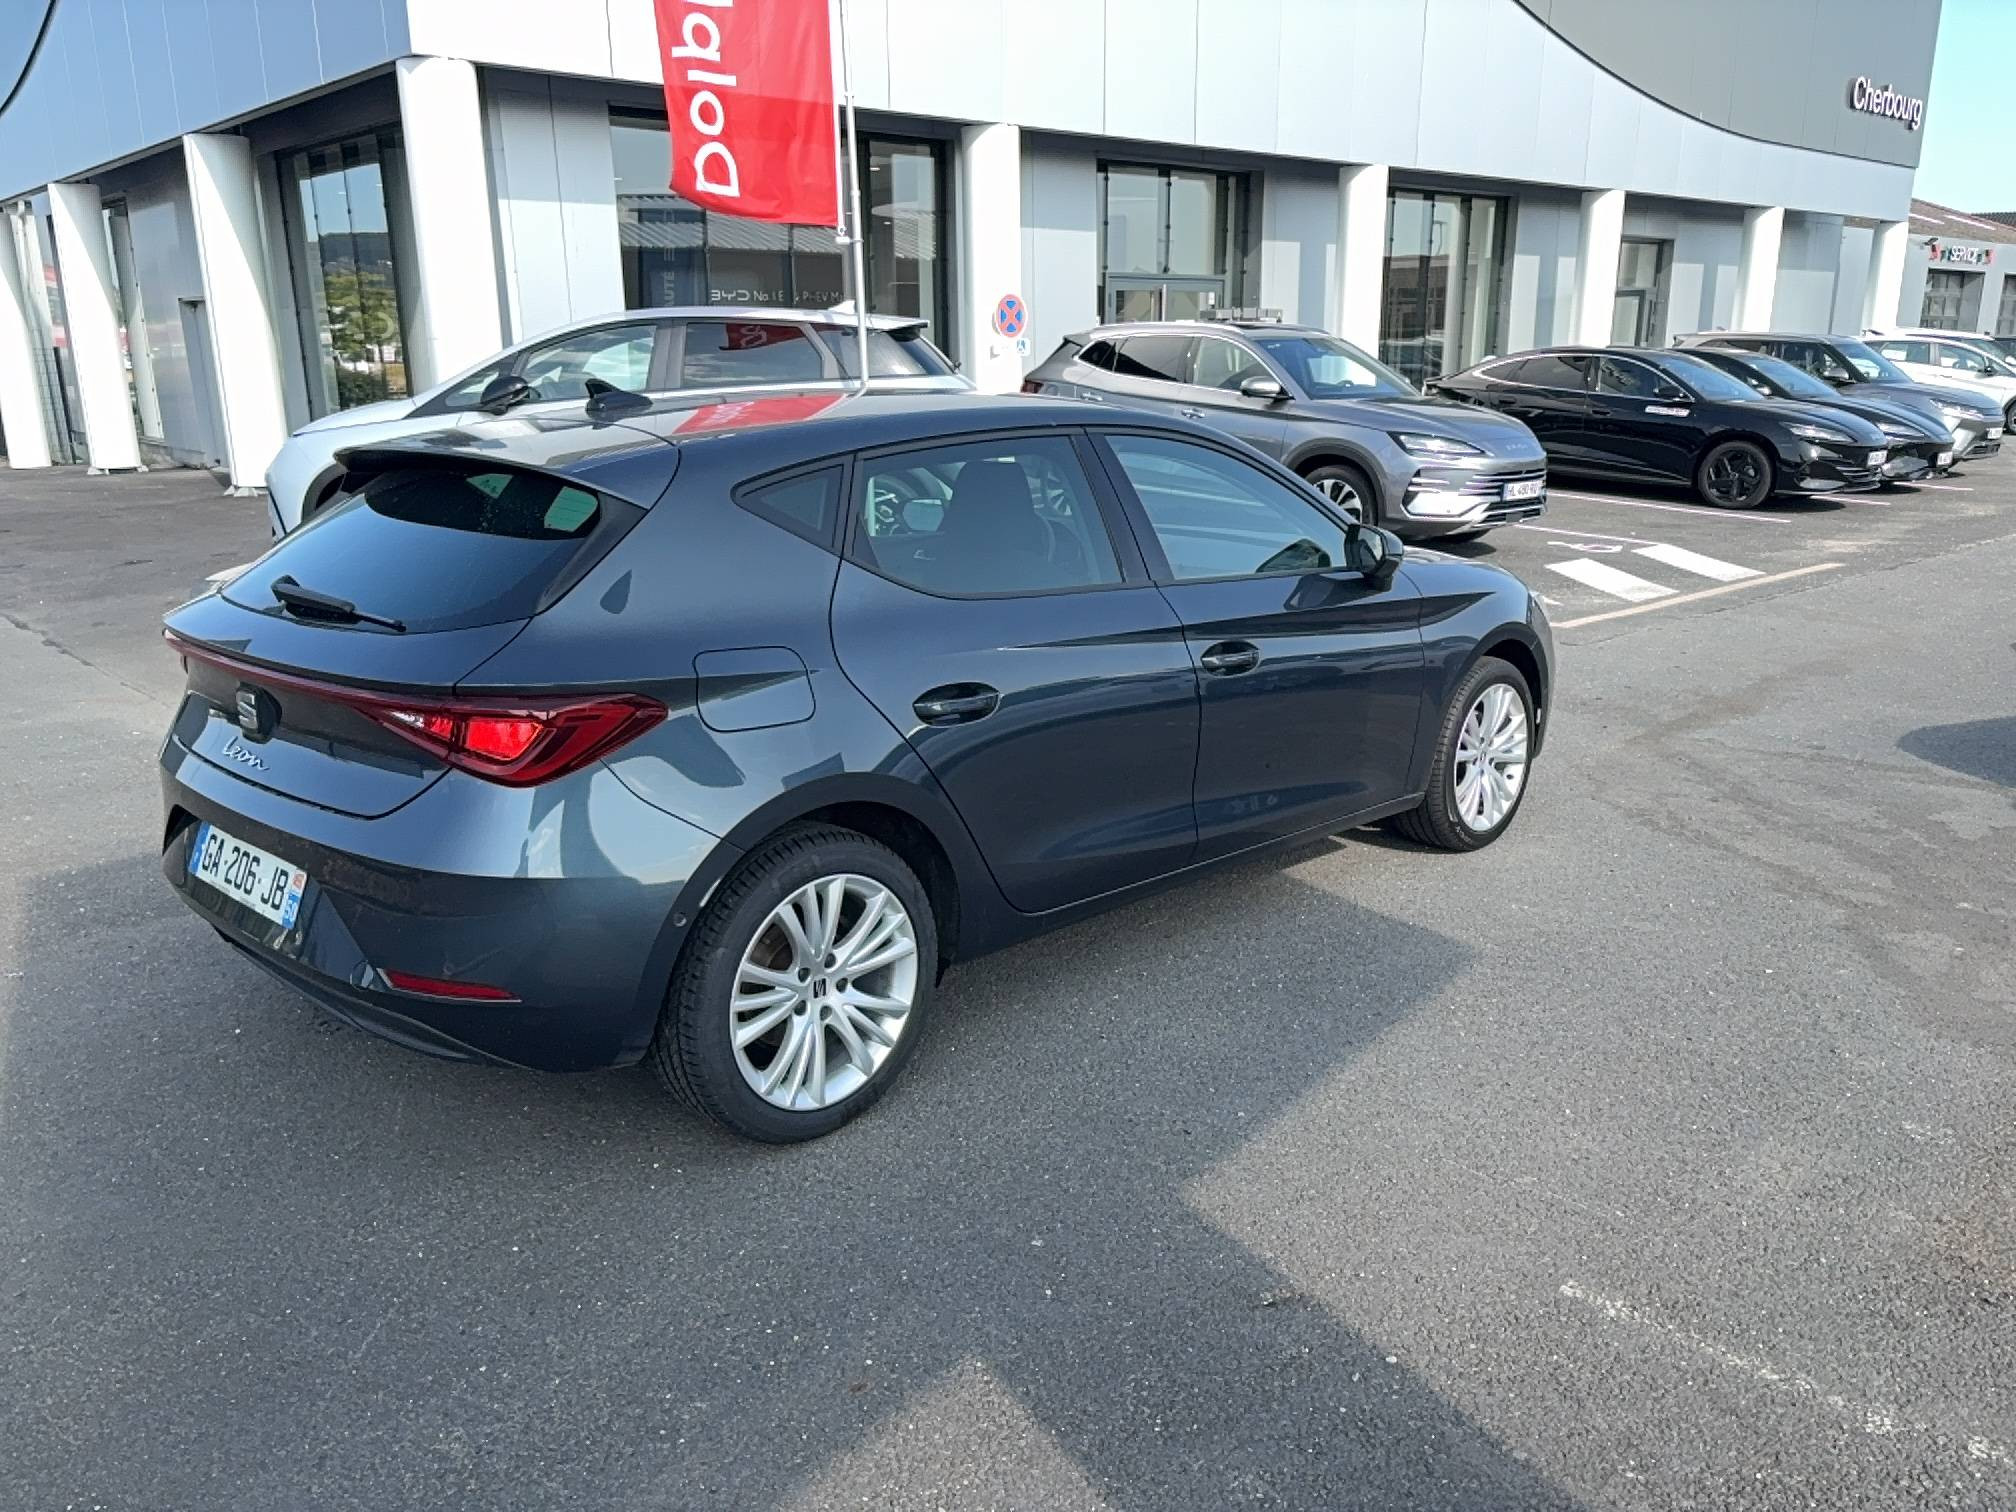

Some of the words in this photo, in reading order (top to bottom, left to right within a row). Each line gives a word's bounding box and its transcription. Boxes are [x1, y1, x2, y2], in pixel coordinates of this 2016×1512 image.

[672, 0, 740, 197] Dolb
[1854, 76, 1922, 130] Cherbourg
[711, 289, 750, 302] BYD
